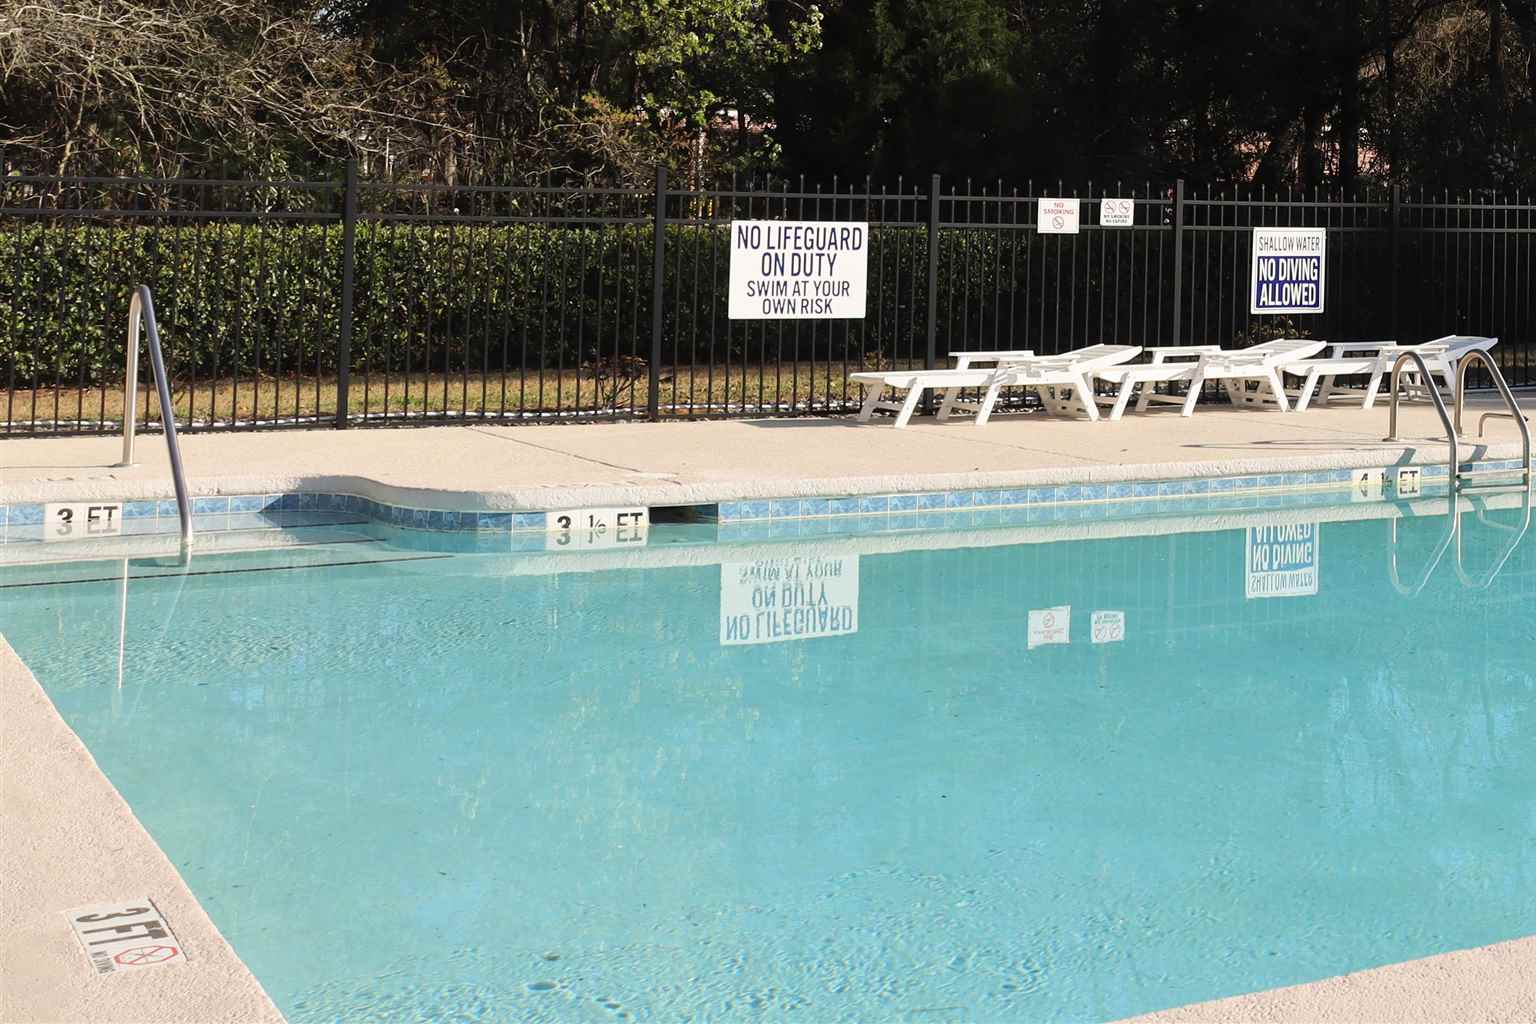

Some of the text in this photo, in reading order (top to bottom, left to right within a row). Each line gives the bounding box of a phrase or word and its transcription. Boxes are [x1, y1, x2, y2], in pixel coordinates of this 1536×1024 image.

[737, 225, 863, 251] NO LIFEGUARD
[1259, 236, 1320, 251] SHALLOW WATER
[761, 252, 837, 277] ON DUTY
[1259, 258, 1318, 281] NO DIVING
[747, 280, 850, 297] SWIM AT YOUR
[1259, 282, 1316, 306] ALLOWED
[762, 298, 833, 315] OWN RISK
